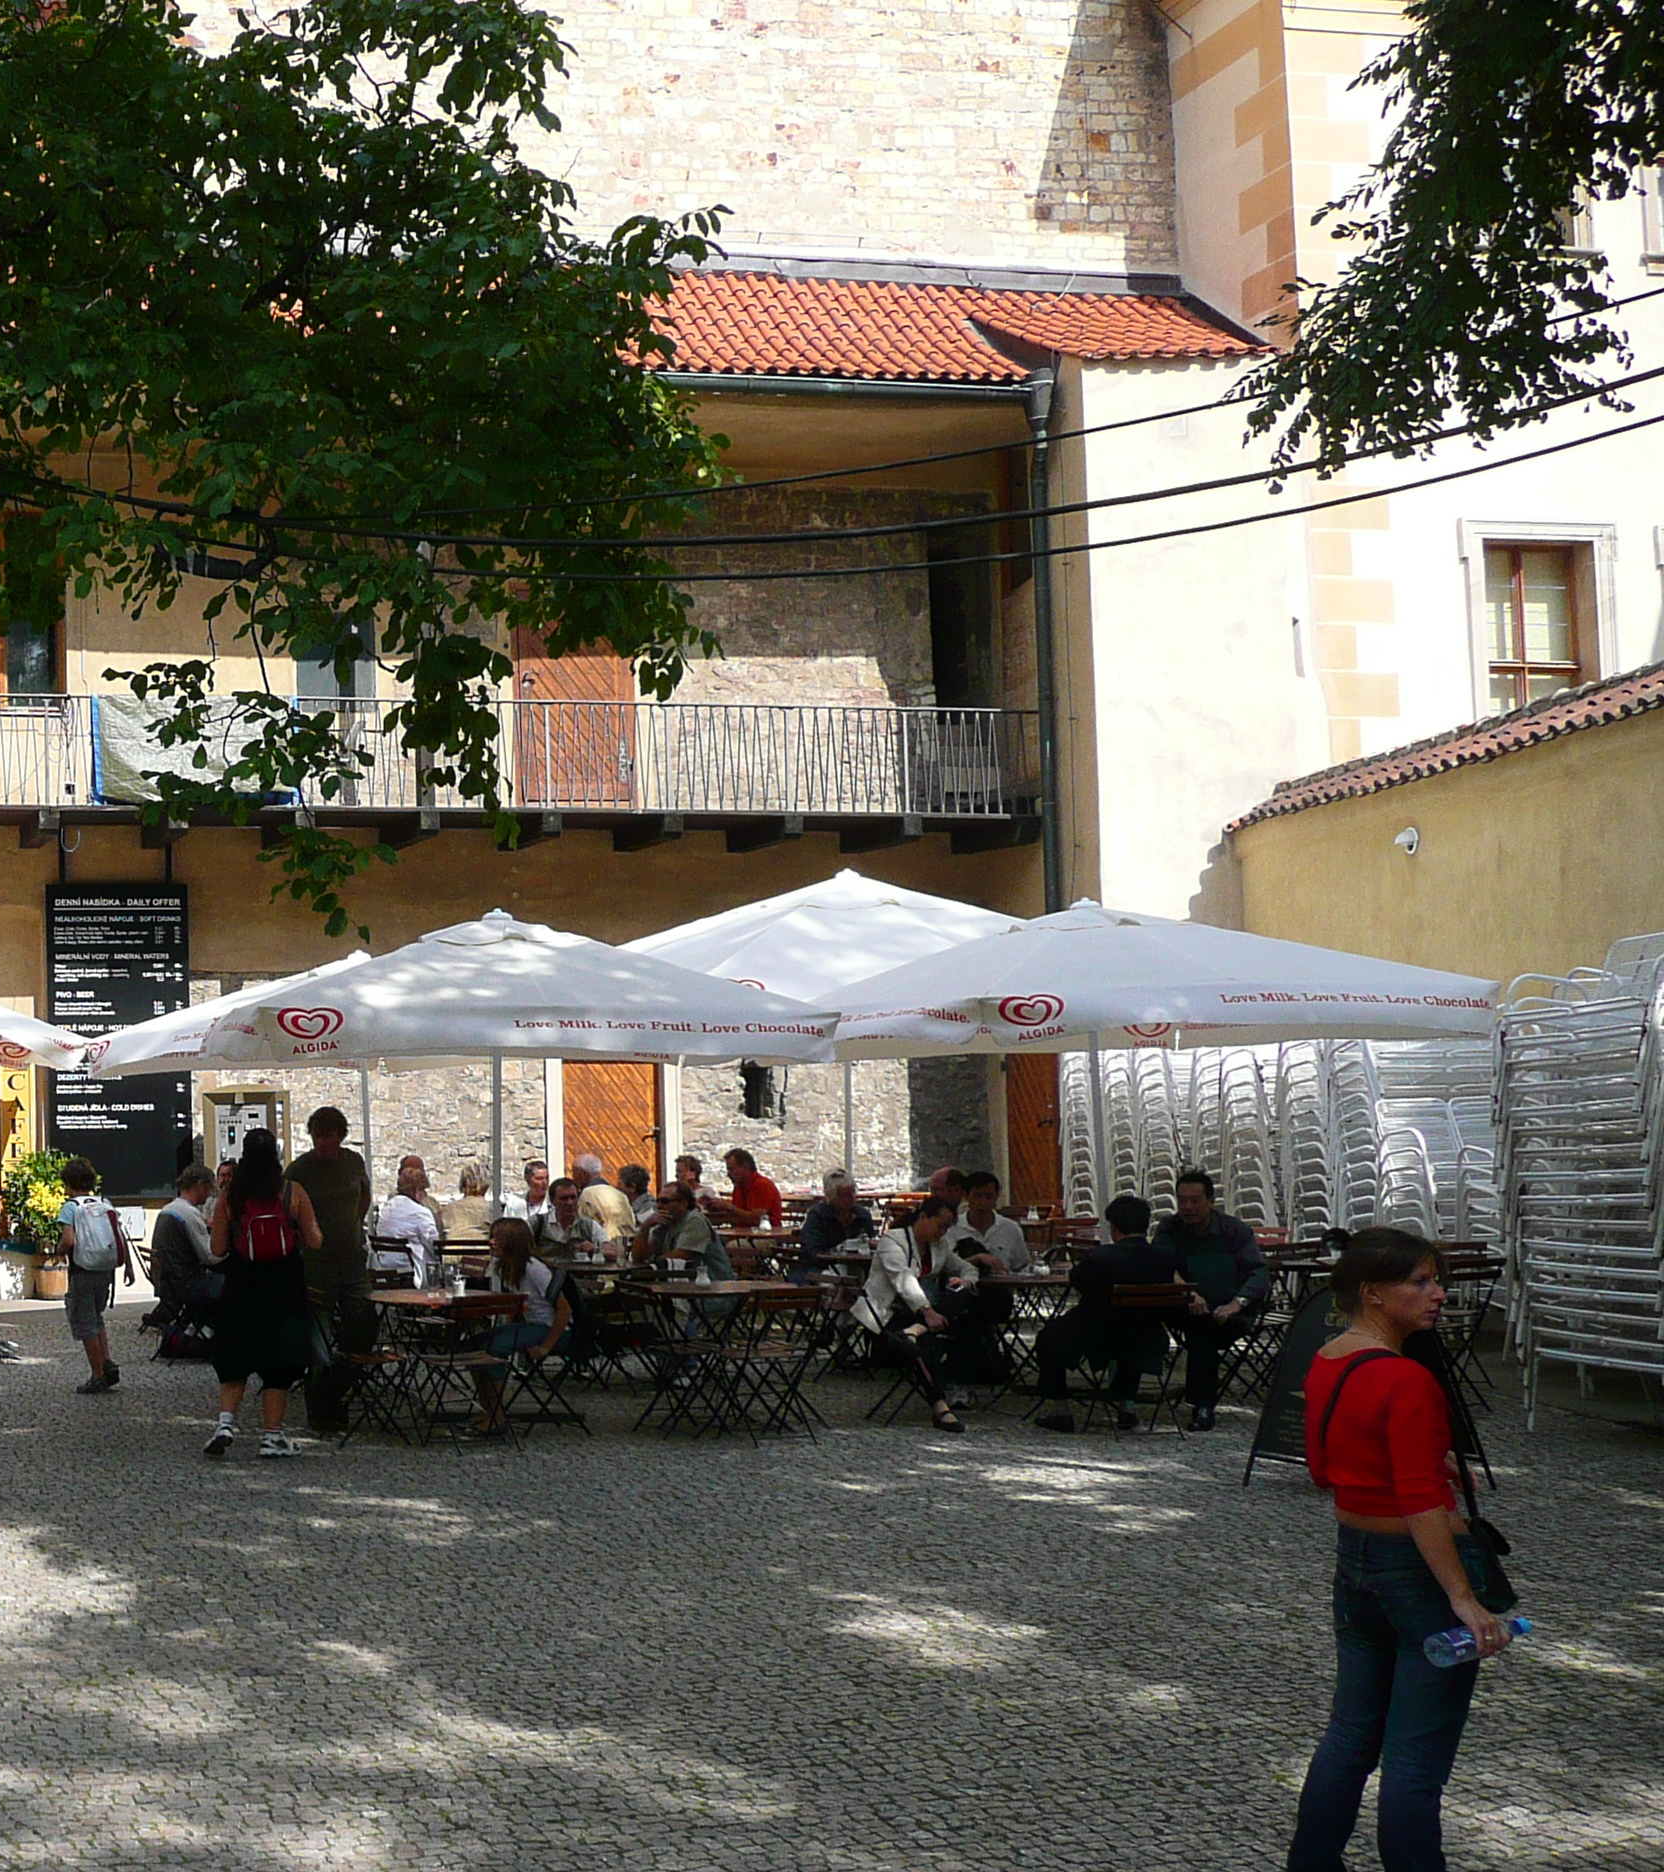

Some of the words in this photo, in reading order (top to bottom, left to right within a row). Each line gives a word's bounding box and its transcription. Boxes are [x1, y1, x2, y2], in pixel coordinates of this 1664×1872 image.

[127, 898, 151, 906] DAILY
[152, 898, 181, 906] OFFER
[1220, 993, 1258, 1004] Love
[1302, 993, 1339, 1004] Love
[1385, 994, 1422, 1006] Love
[514, 1019, 553, 1029] Love
[607, 1020, 646, 1030] Love
[701, 1022, 741, 1034] Love
[1018, 1024, 1065, 1041] ALGIDA
[293, 1041, 338, 1055] ALGIDA
[7, 1073, 26, 1159] CAFÉ
